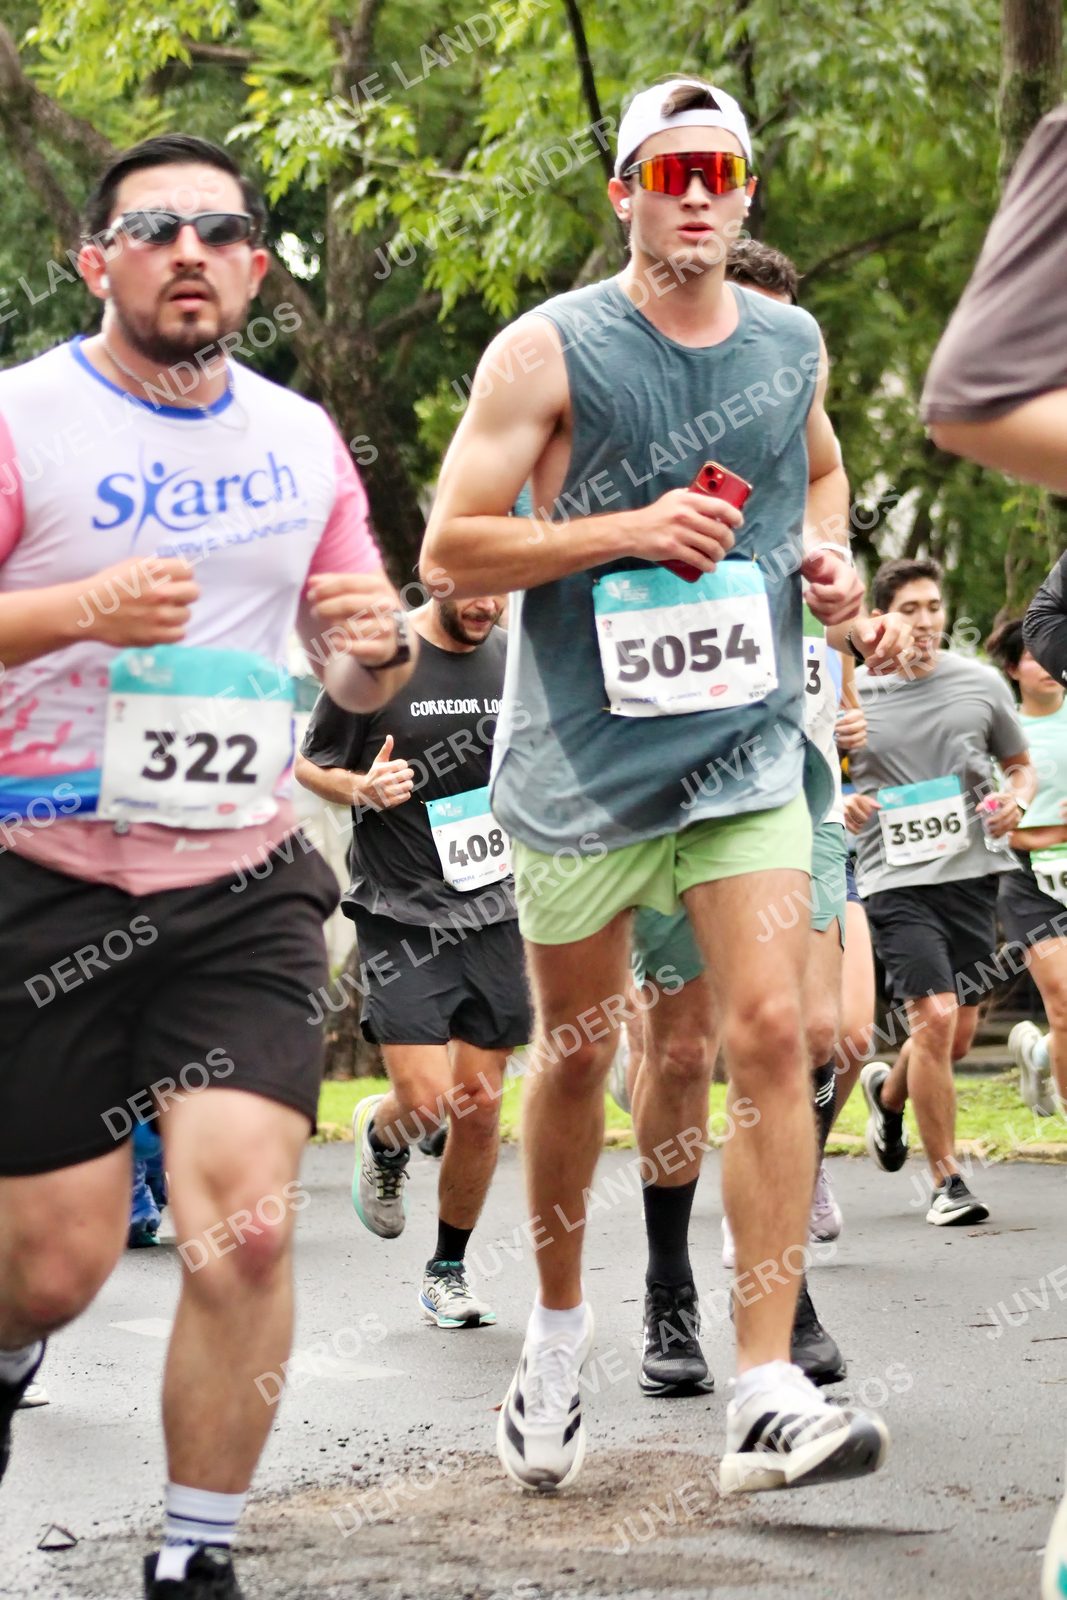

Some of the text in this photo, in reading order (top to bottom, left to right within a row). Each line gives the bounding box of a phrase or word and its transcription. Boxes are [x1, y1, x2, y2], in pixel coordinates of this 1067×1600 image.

[615, 623, 761, 683] 5054
[805, 659, 822, 696] 3
[410, 698, 481, 717] CORREDOR
[141, 729, 258, 785] 322
[448, 828, 512, 867] 408
[888, 811, 962, 846] 3596
